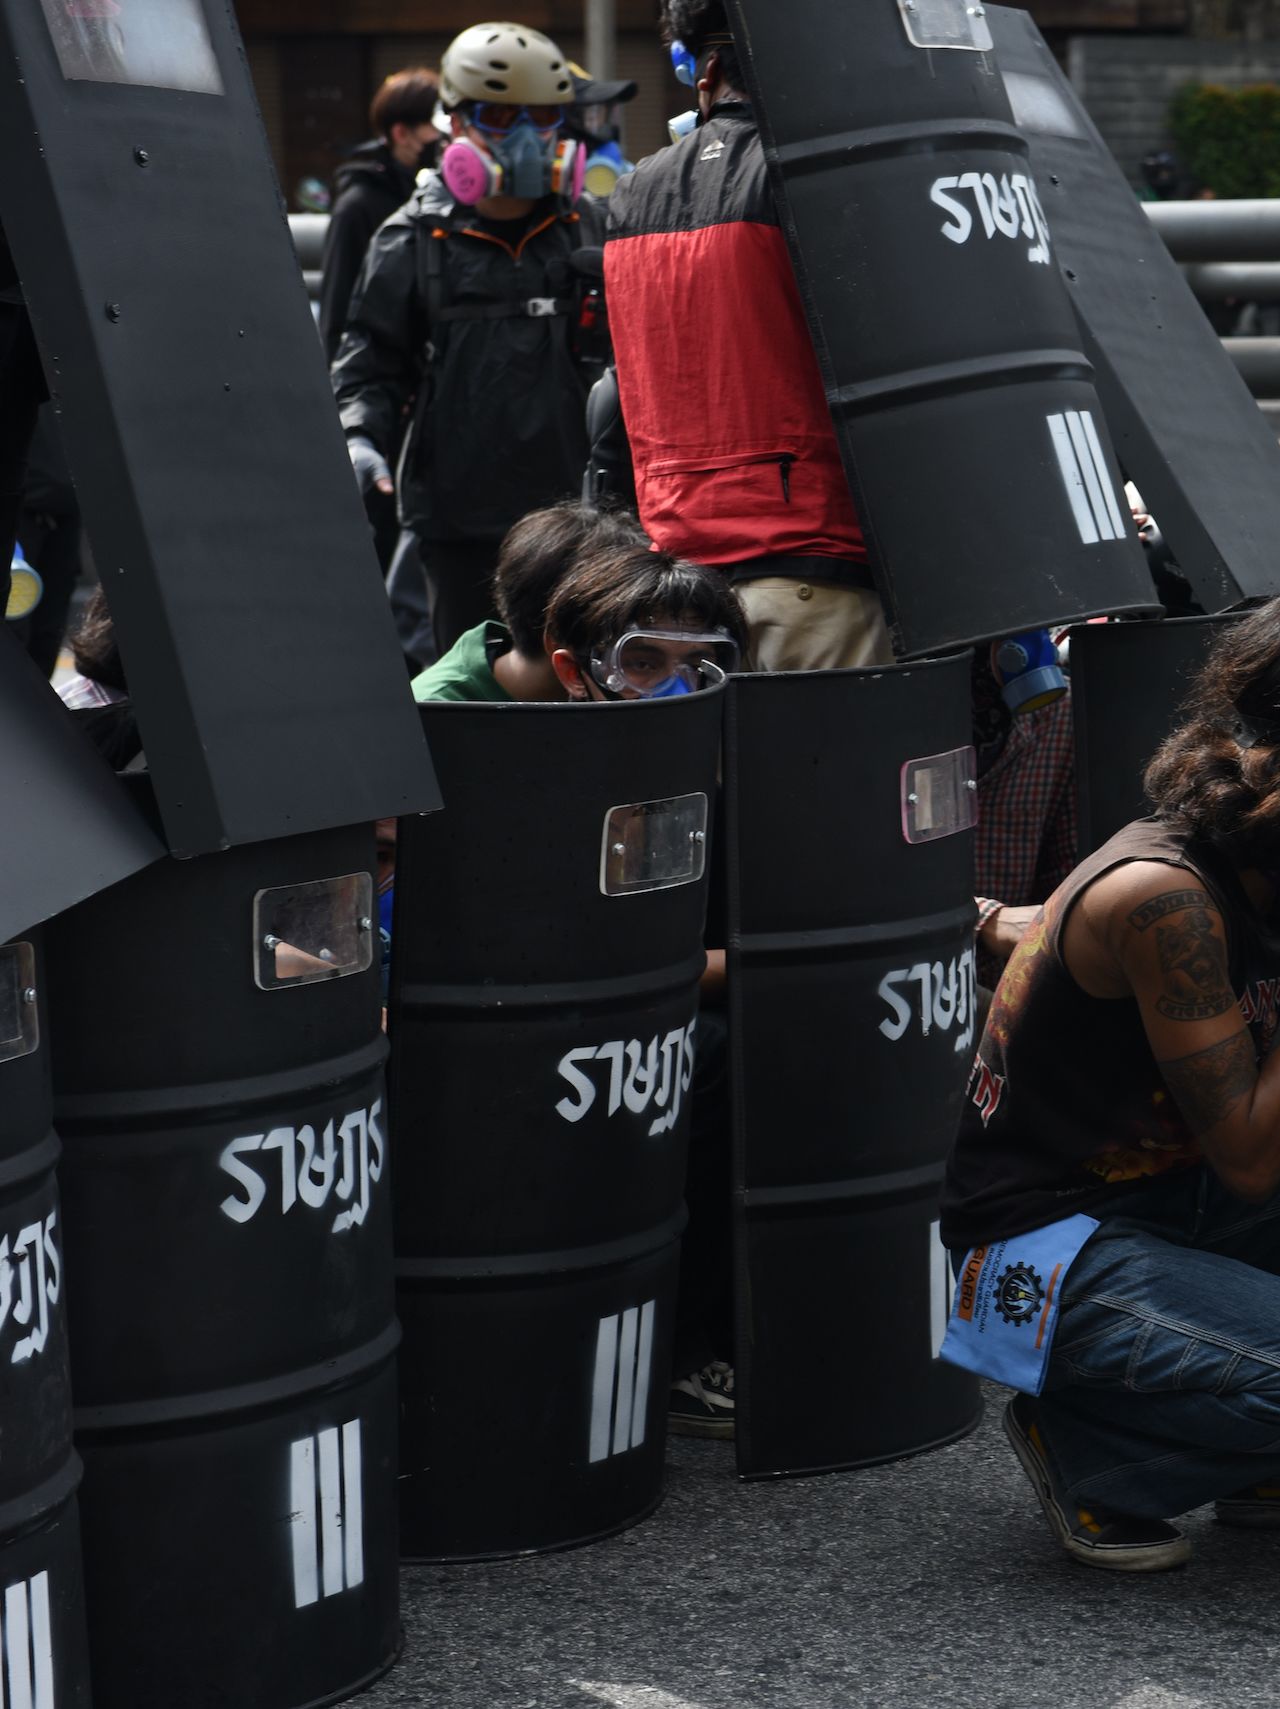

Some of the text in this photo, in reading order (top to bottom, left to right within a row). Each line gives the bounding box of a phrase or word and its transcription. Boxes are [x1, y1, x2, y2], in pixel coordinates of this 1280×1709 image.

[878, 949, 977, 1052] ราษฎ
[555, 1017, 697, 1137] ราษฎร
[219, 1097, 384, 1233] ราษฎร
[961, 1246, 985, 1311] GUARD
